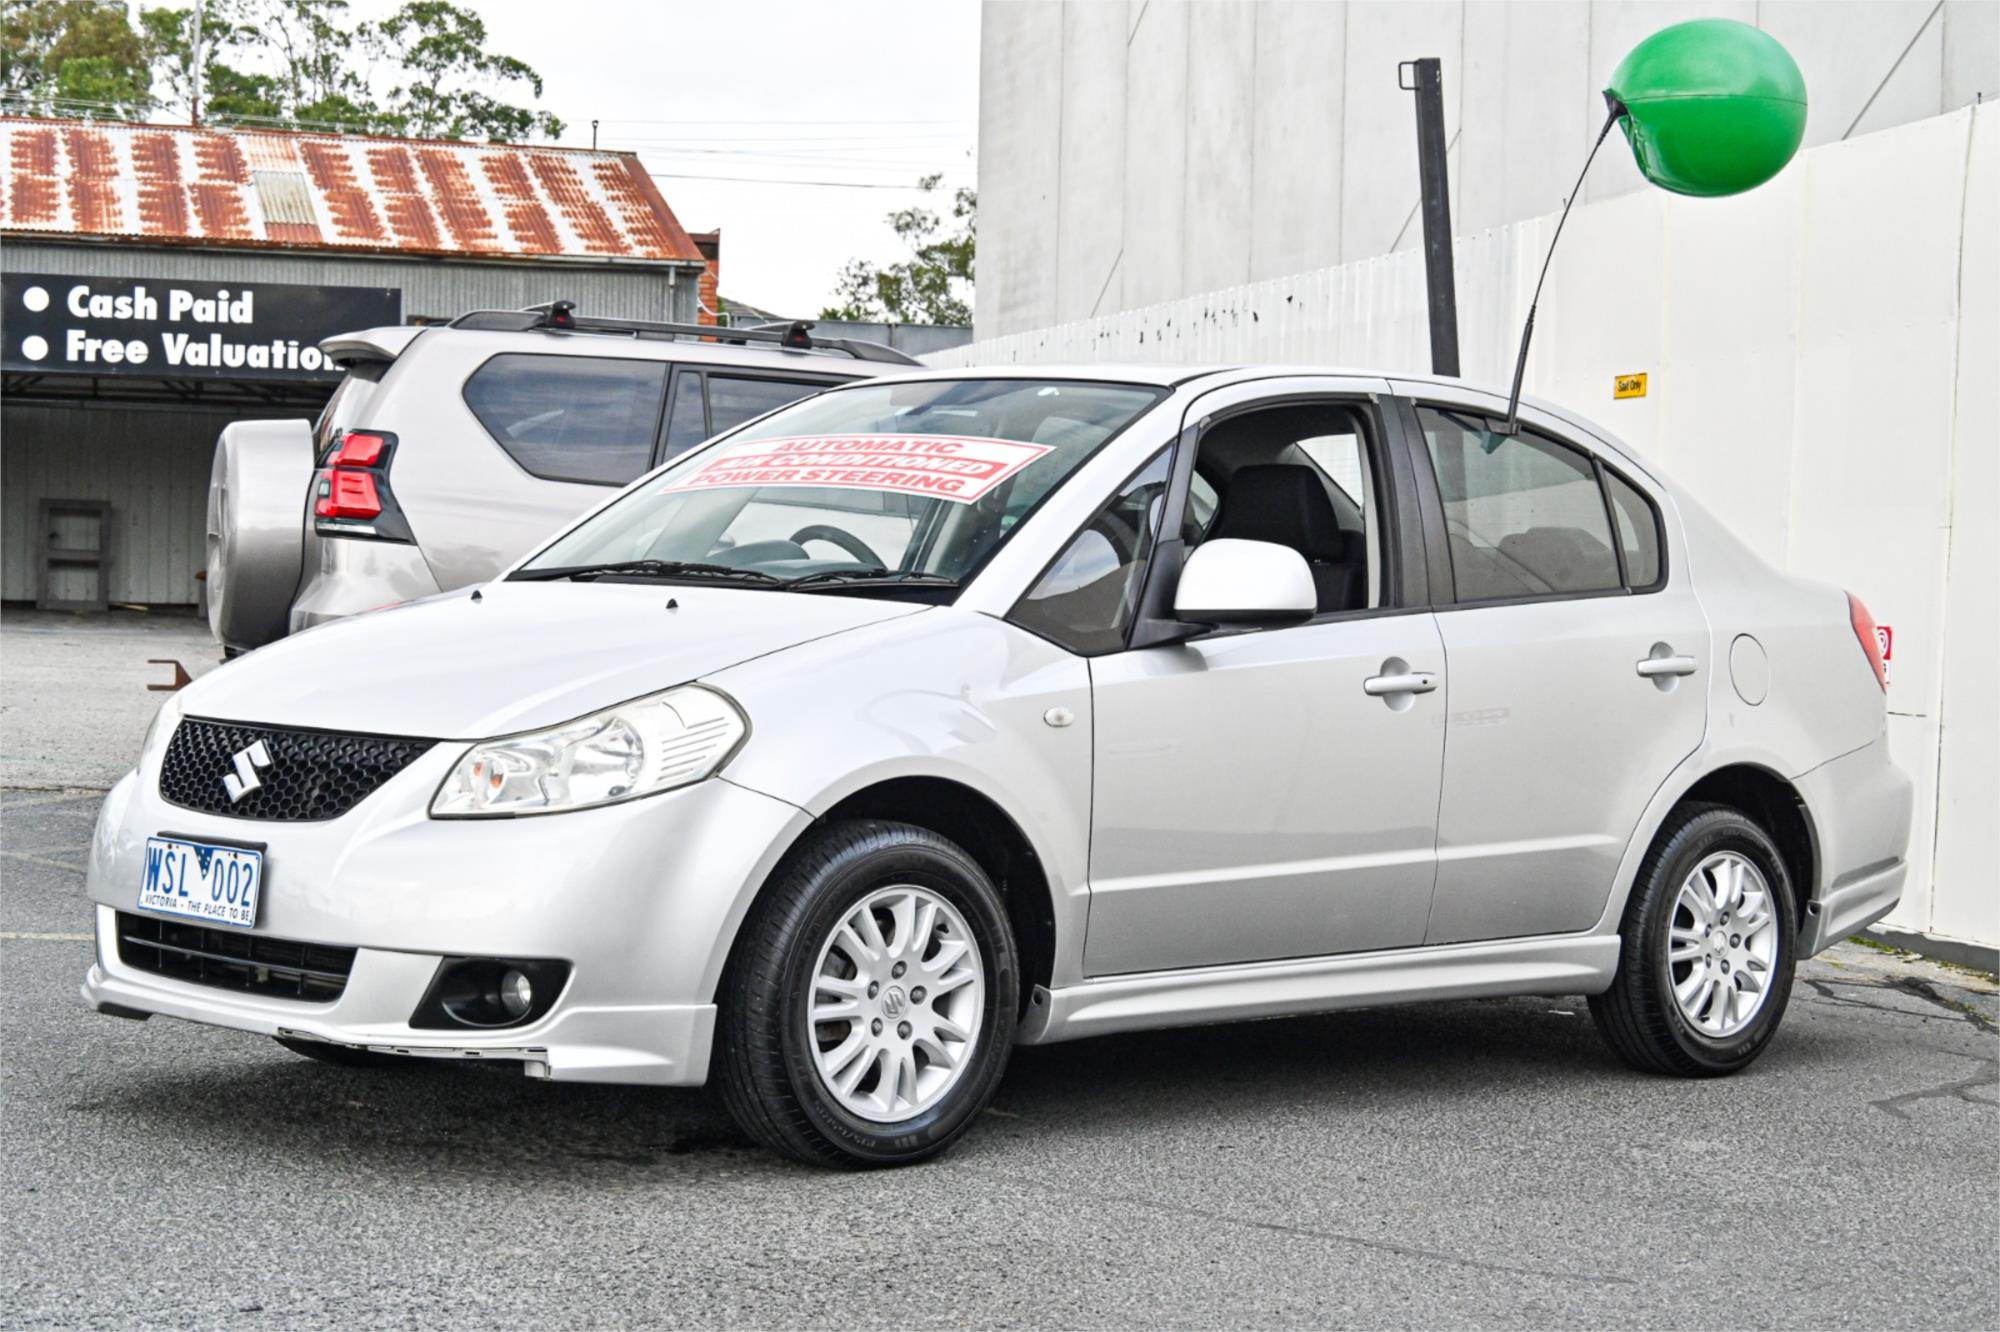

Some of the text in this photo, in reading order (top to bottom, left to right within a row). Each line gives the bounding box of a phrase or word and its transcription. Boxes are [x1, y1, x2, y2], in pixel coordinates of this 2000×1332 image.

[66, 285, 254, 324] Cash Paid
[66, 329, 149, 364] Free
[772, 439, 964, 455] AUTOMATIC
[718, 452, 993, 476] AIR CONDITIONED
[688, 468, 966, 493] POWER STEERING
[146, 847, 253, 908] WSL 002
[145, 895, 177, 908] VICTORIA
[188, 900, 200, 913] THE
[204, 903, 226, 917] PLACE
[229, 907, 238, 919] TO
[241, 909, 250, 921] BE
